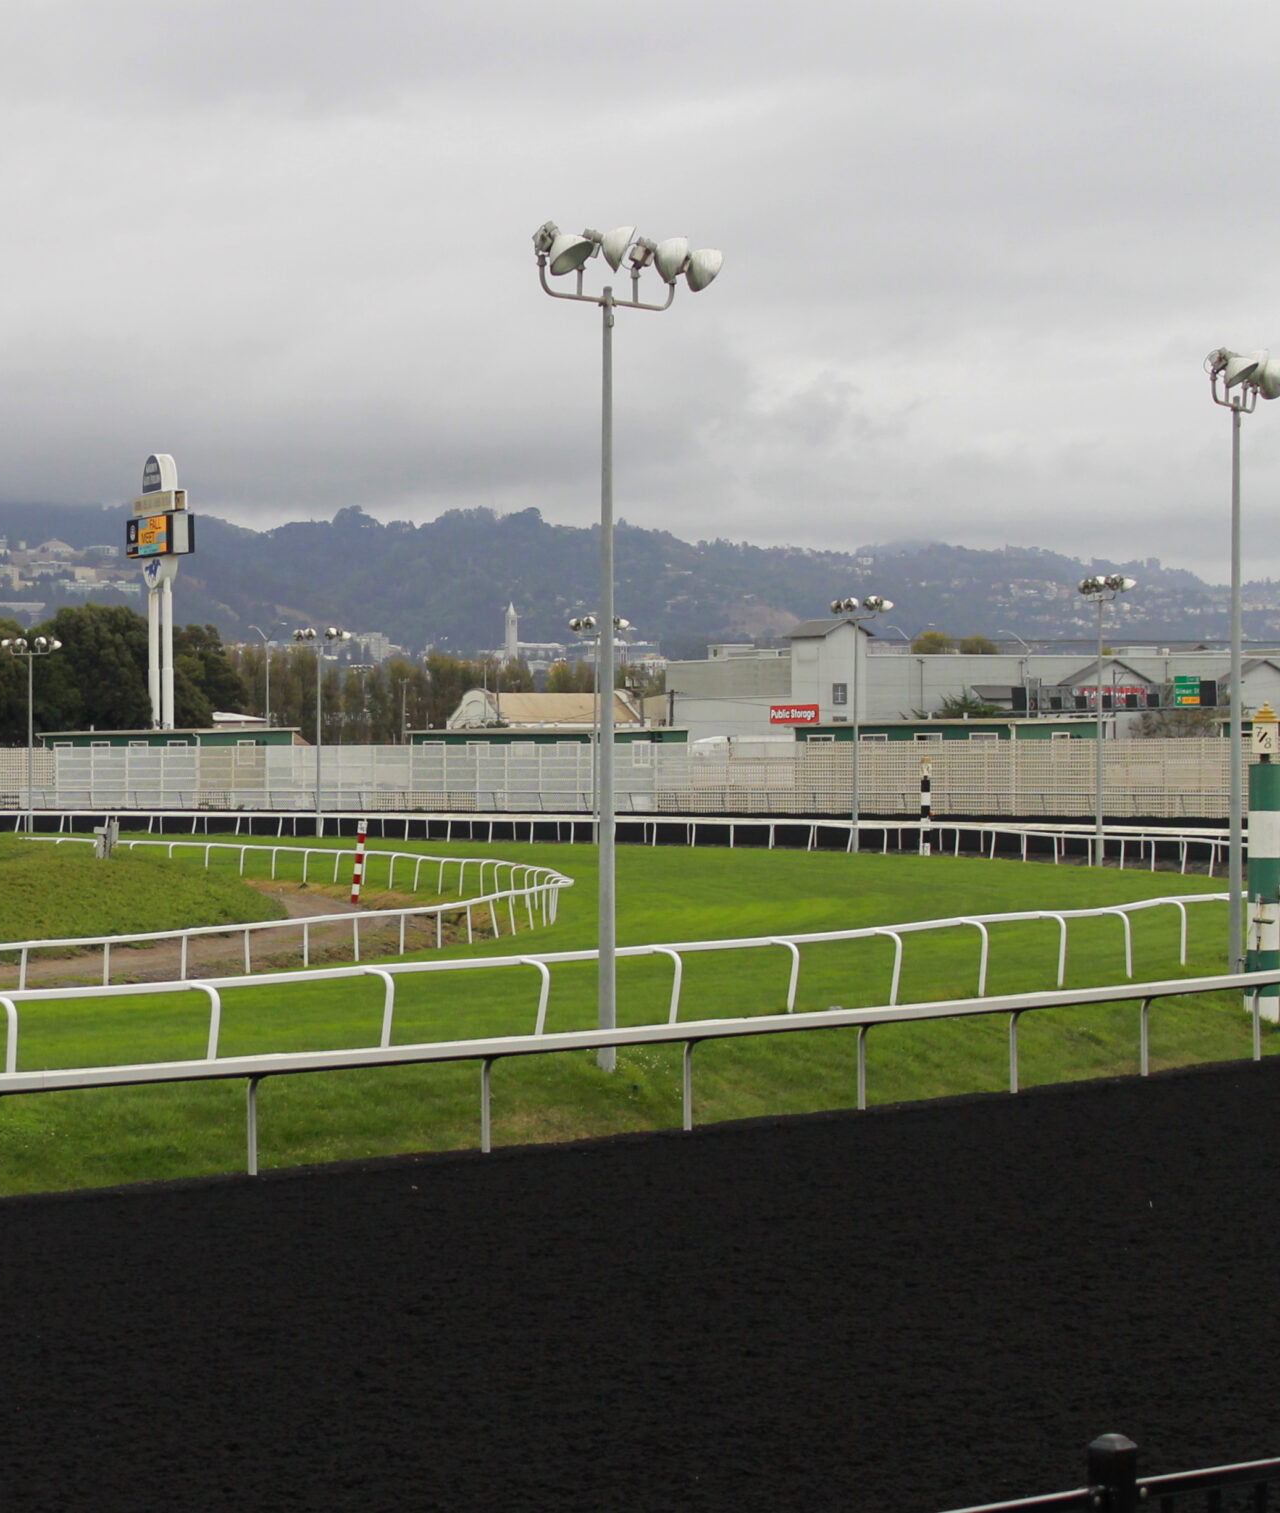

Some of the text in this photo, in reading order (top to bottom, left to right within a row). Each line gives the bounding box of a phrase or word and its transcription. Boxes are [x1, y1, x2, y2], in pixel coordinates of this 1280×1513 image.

[149, 516, 162, 530] FALL
[141, 531, 156, 544] MEET
[771, 708, 815, 721] Public Storage
